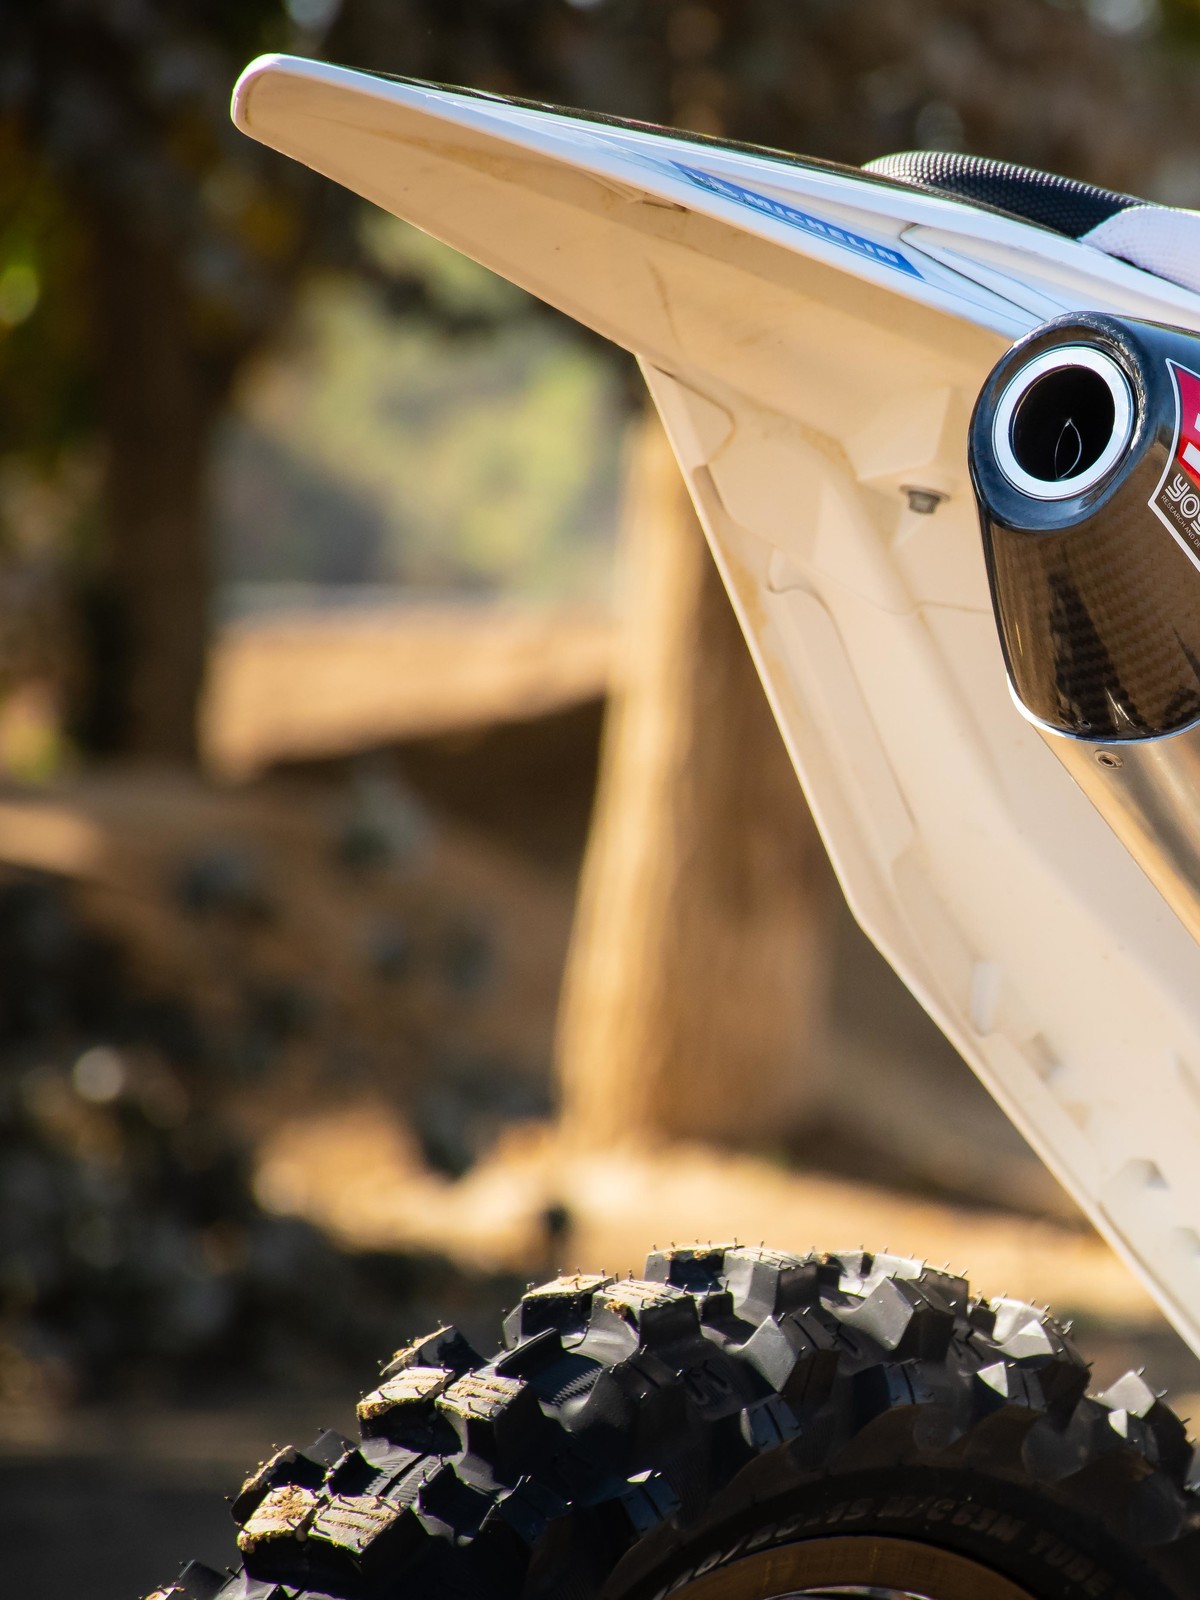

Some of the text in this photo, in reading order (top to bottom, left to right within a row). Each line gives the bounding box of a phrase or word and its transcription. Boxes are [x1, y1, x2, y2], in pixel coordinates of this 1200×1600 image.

[742, 191, 900, 264] MICHELIN
[1160, 494, 1187, 528] RESEARCH
[1184, 526, 1196, 541] AND
